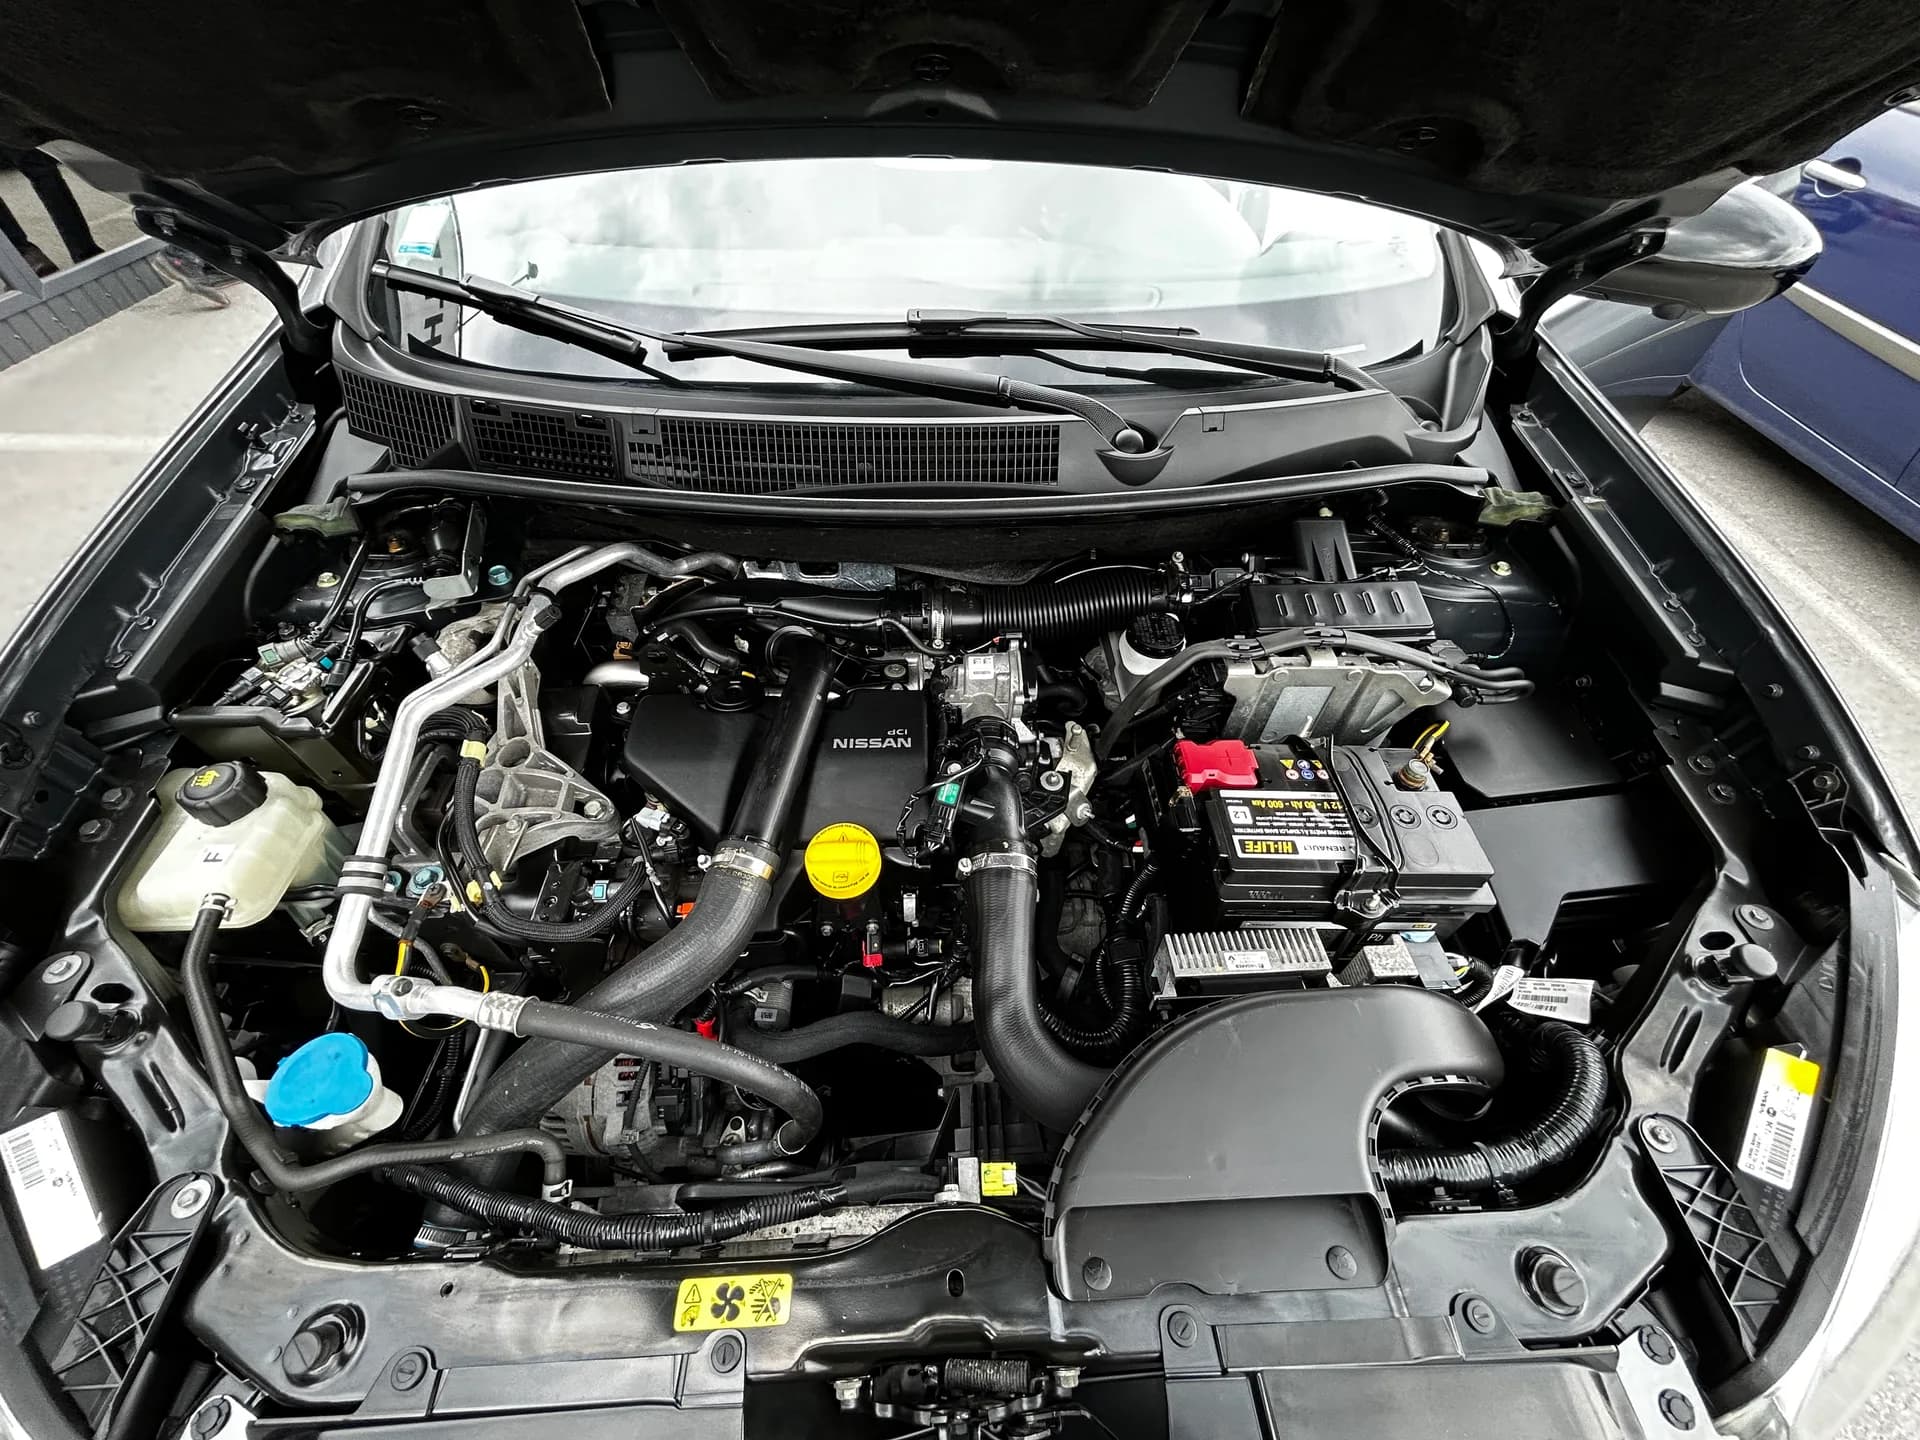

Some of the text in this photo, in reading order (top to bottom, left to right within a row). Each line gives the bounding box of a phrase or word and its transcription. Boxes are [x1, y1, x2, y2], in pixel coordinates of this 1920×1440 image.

[833, 737, 912, 749] NISSAN
[1232, 810, 1248, 819] L2
[1303, 843, 1347, 852] RENAULT
[203, 851, 223, 863] F
[1367, 933, 1384, 942] Pb
